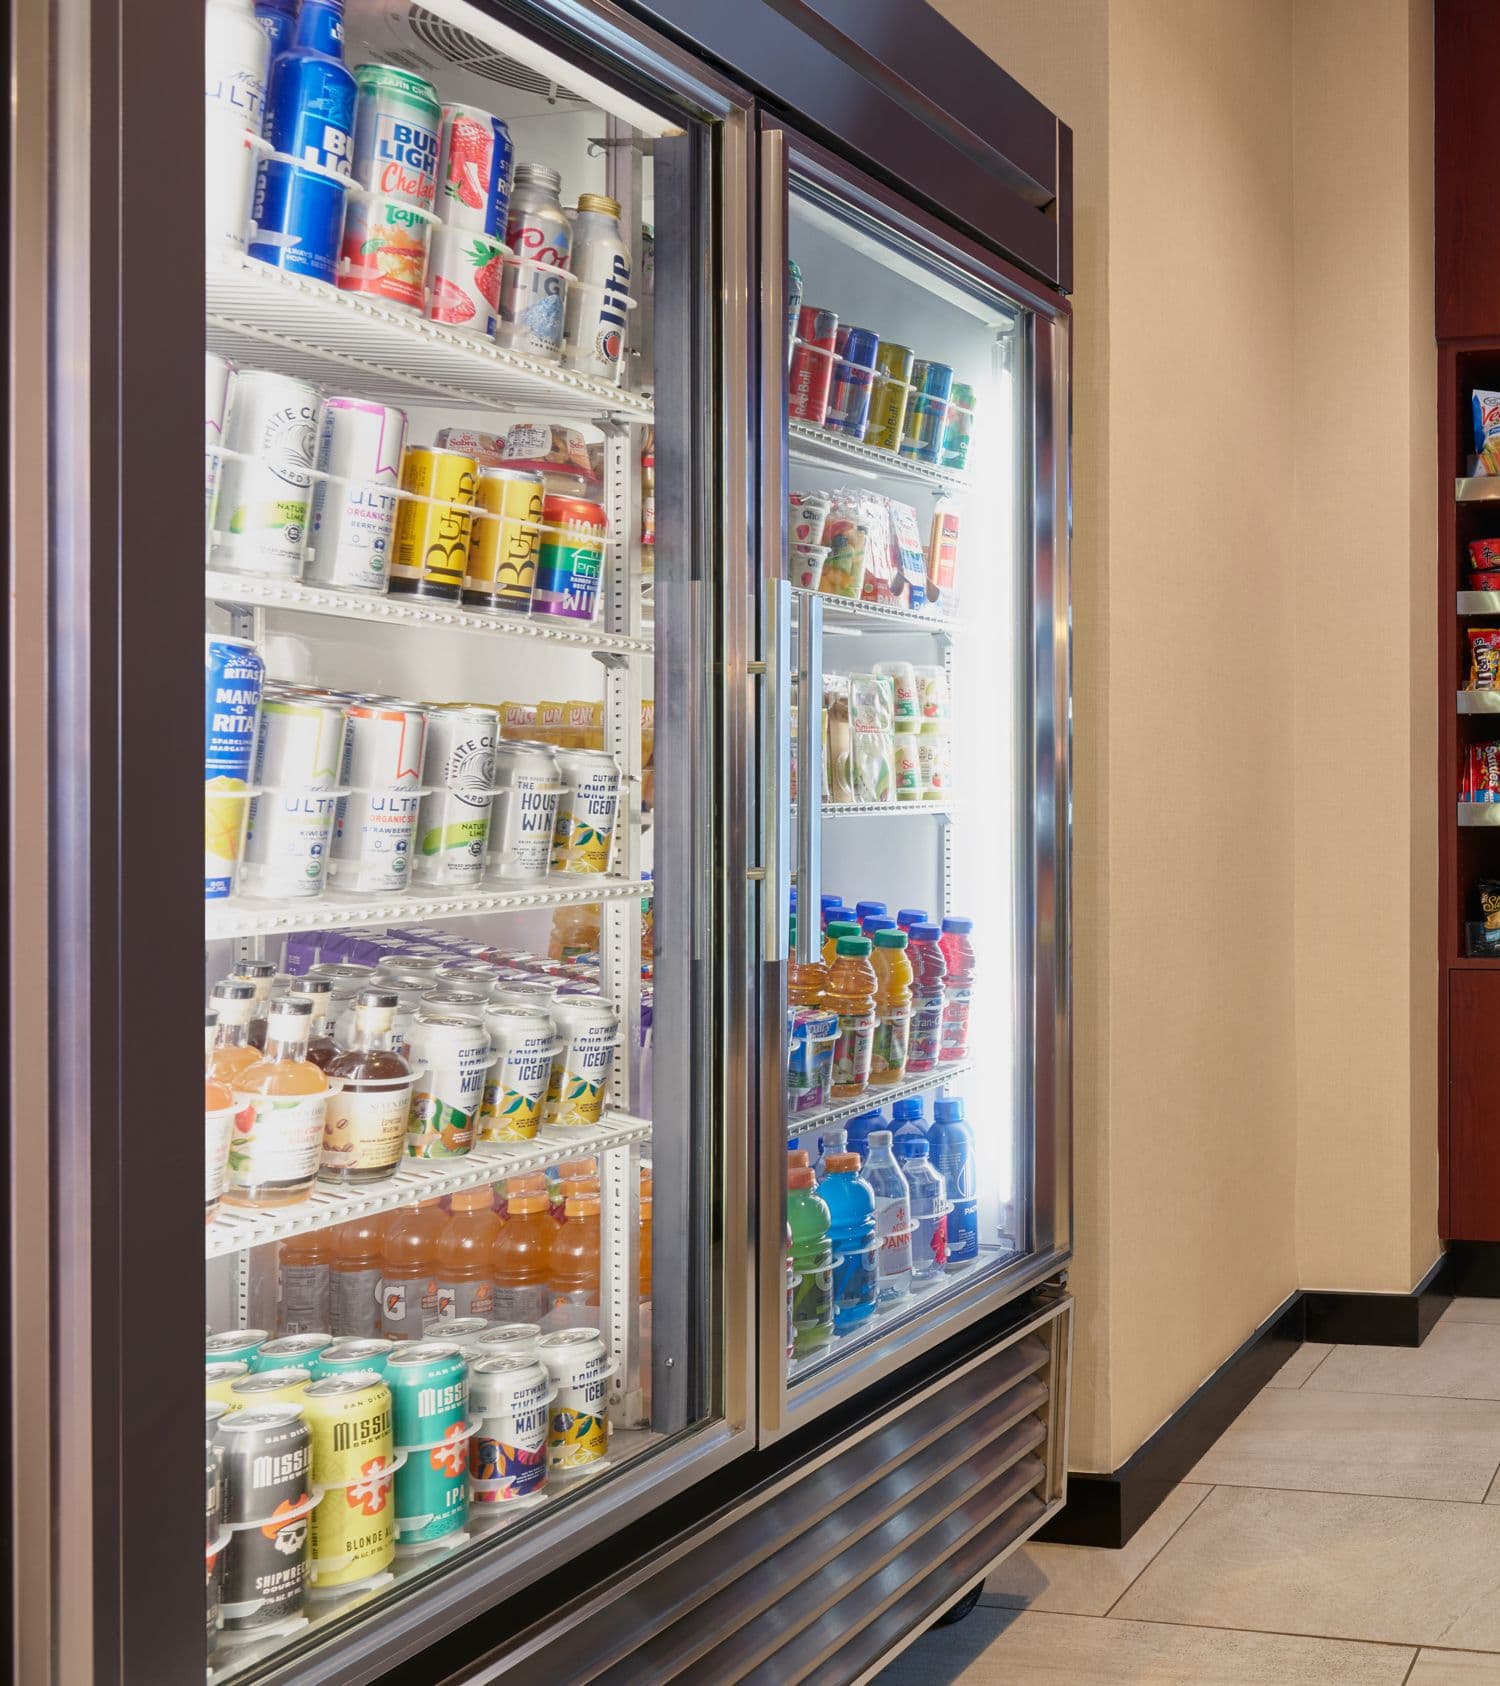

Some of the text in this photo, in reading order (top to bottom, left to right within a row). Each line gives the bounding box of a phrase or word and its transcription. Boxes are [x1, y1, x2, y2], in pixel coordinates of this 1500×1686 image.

[380, 140, 437, 175] LIGH
[517, 781, 536, 790] THE
[445, 1485, 466, 1508] IPA
[346, 1530, 383, 1553] BLONDE
